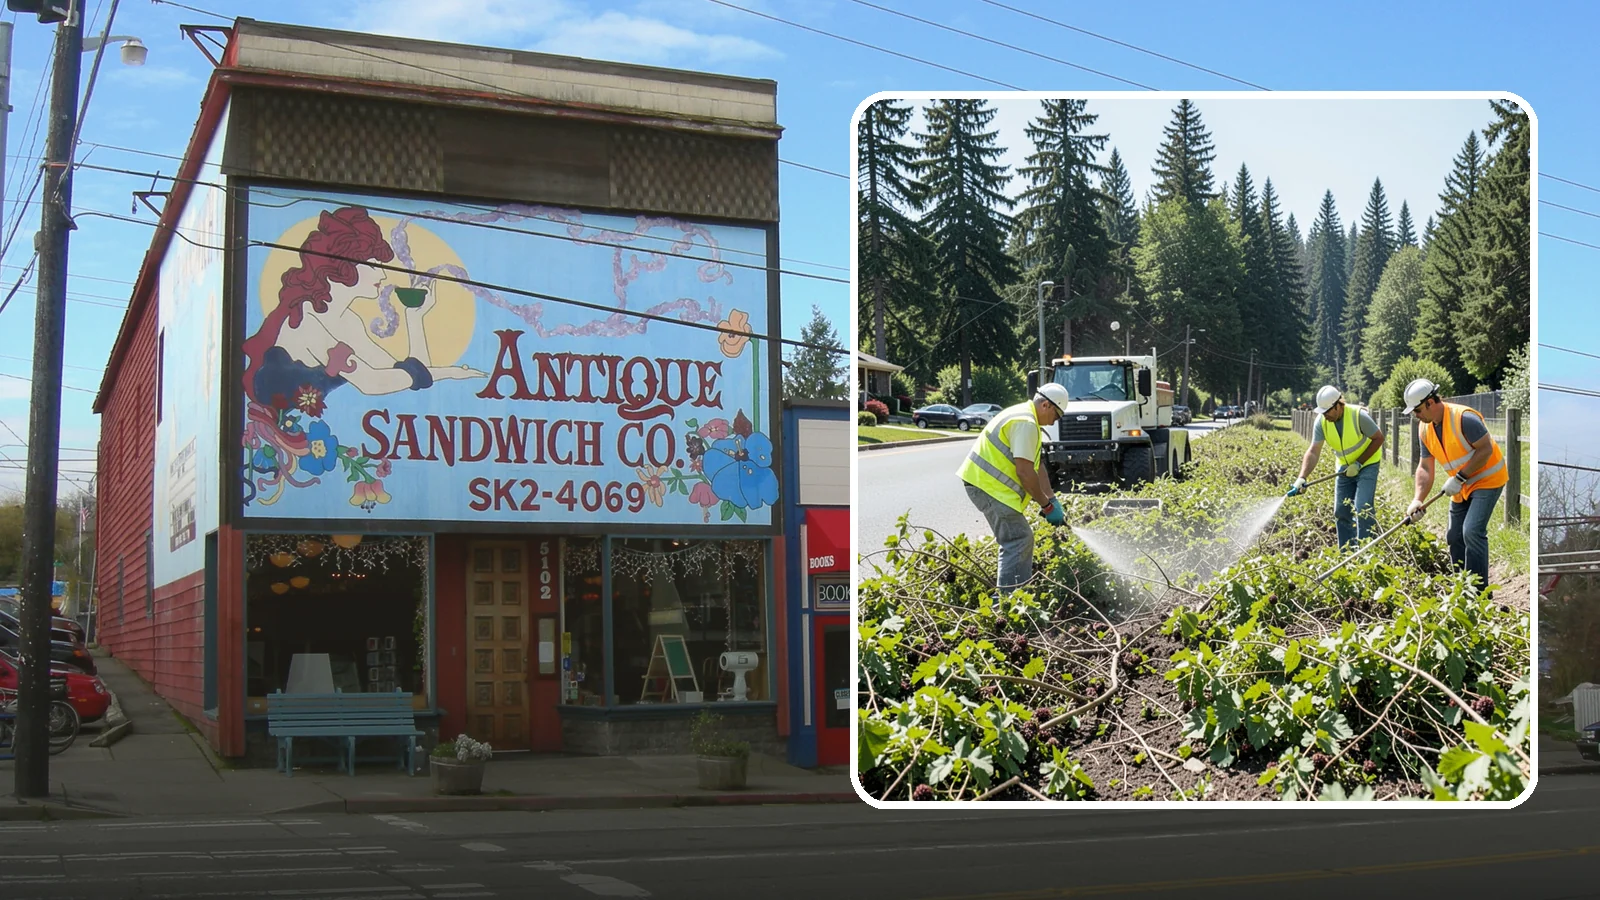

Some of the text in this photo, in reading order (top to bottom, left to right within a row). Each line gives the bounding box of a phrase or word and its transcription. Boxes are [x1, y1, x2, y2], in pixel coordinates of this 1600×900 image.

[475, 329, 724, 421] ANTIQUE
[361, 409, 686, 469] SANDWICH CO.
[468, 477, 645, 514] SK2-4069
[540, 541, 551, 600] 5102
[809, 555, 835, 569] BOOKS
